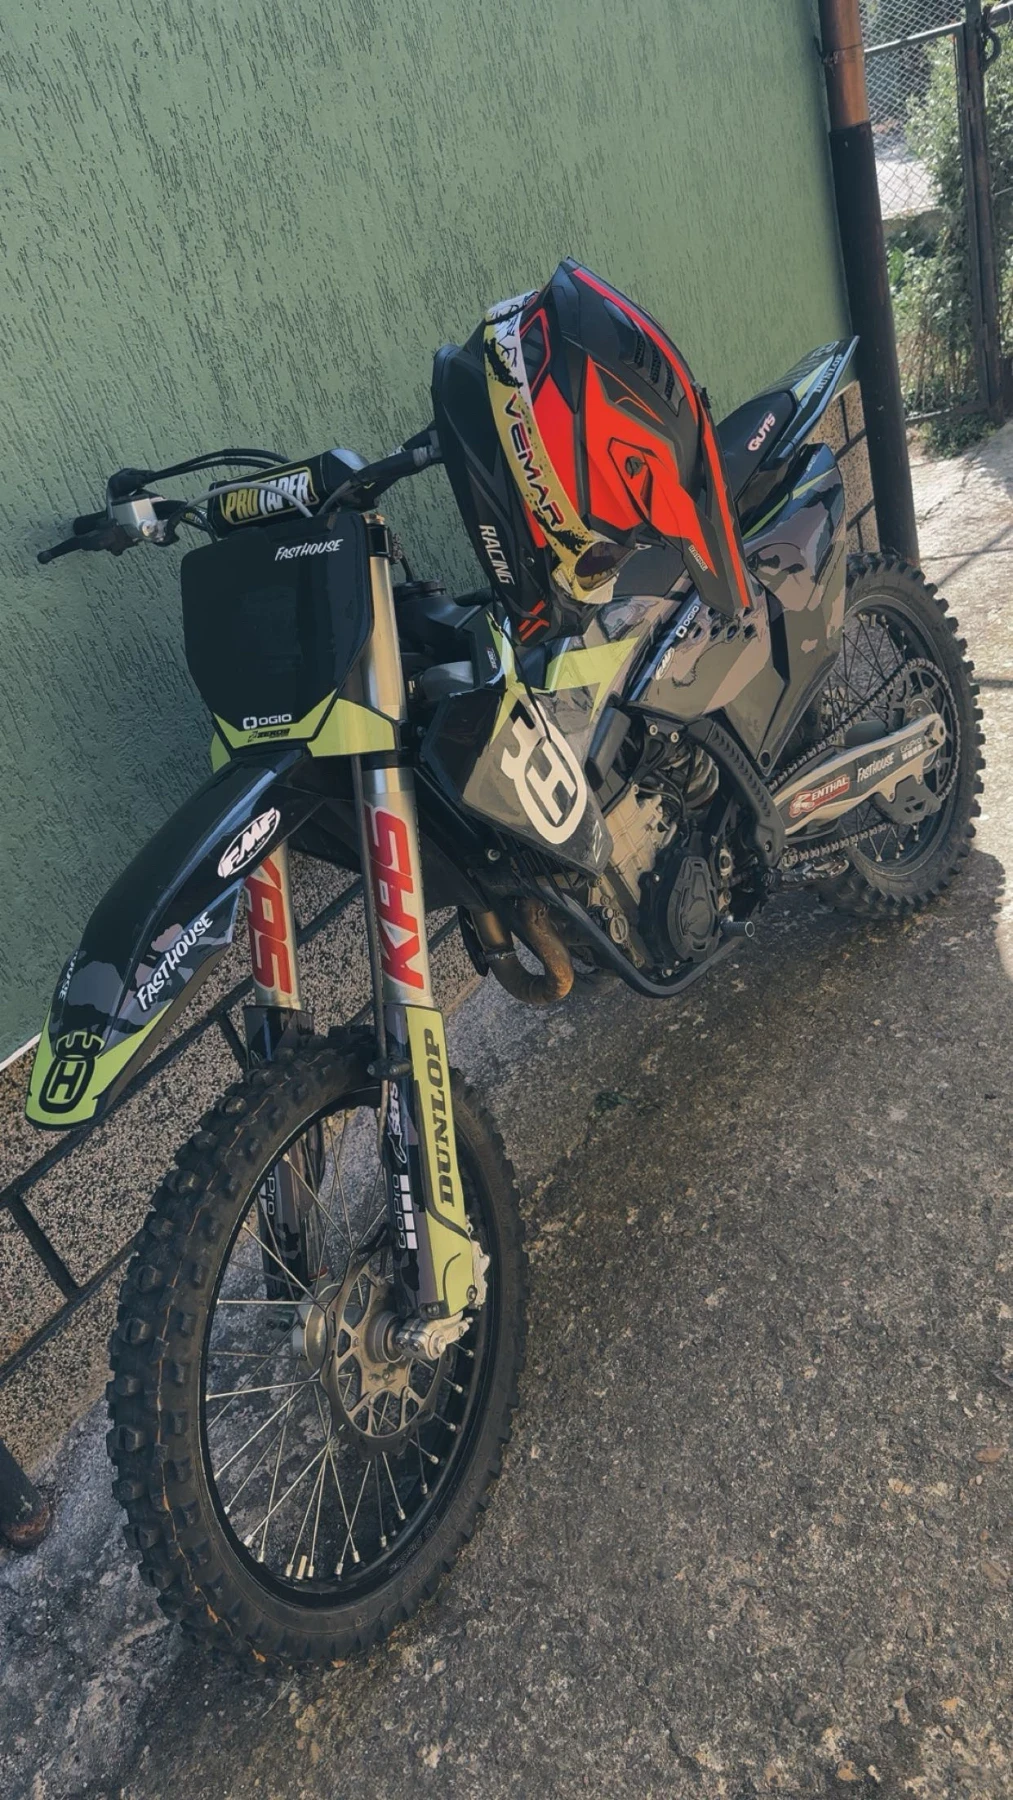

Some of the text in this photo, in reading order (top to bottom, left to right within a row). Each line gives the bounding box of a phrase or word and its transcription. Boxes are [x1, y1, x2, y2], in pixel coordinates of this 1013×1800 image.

[505, 393, 565, 526] VEMAR
[748, 412, 776, 451] GUTS
[275, 539, 344, 561] FASTHOUSE
[479, 524, 515, 585] RACING
[258, 713, 293, 726] OGIO
[857, 752, 895, 783] FASTHOUSE
[220, 807, 276, 879] FMF
[136, 912, 213, 1011] FASTHOUSE
[424, 1028, 455, 1207] DUNLOP
[392, 1174, 407, 1249] GoPro
